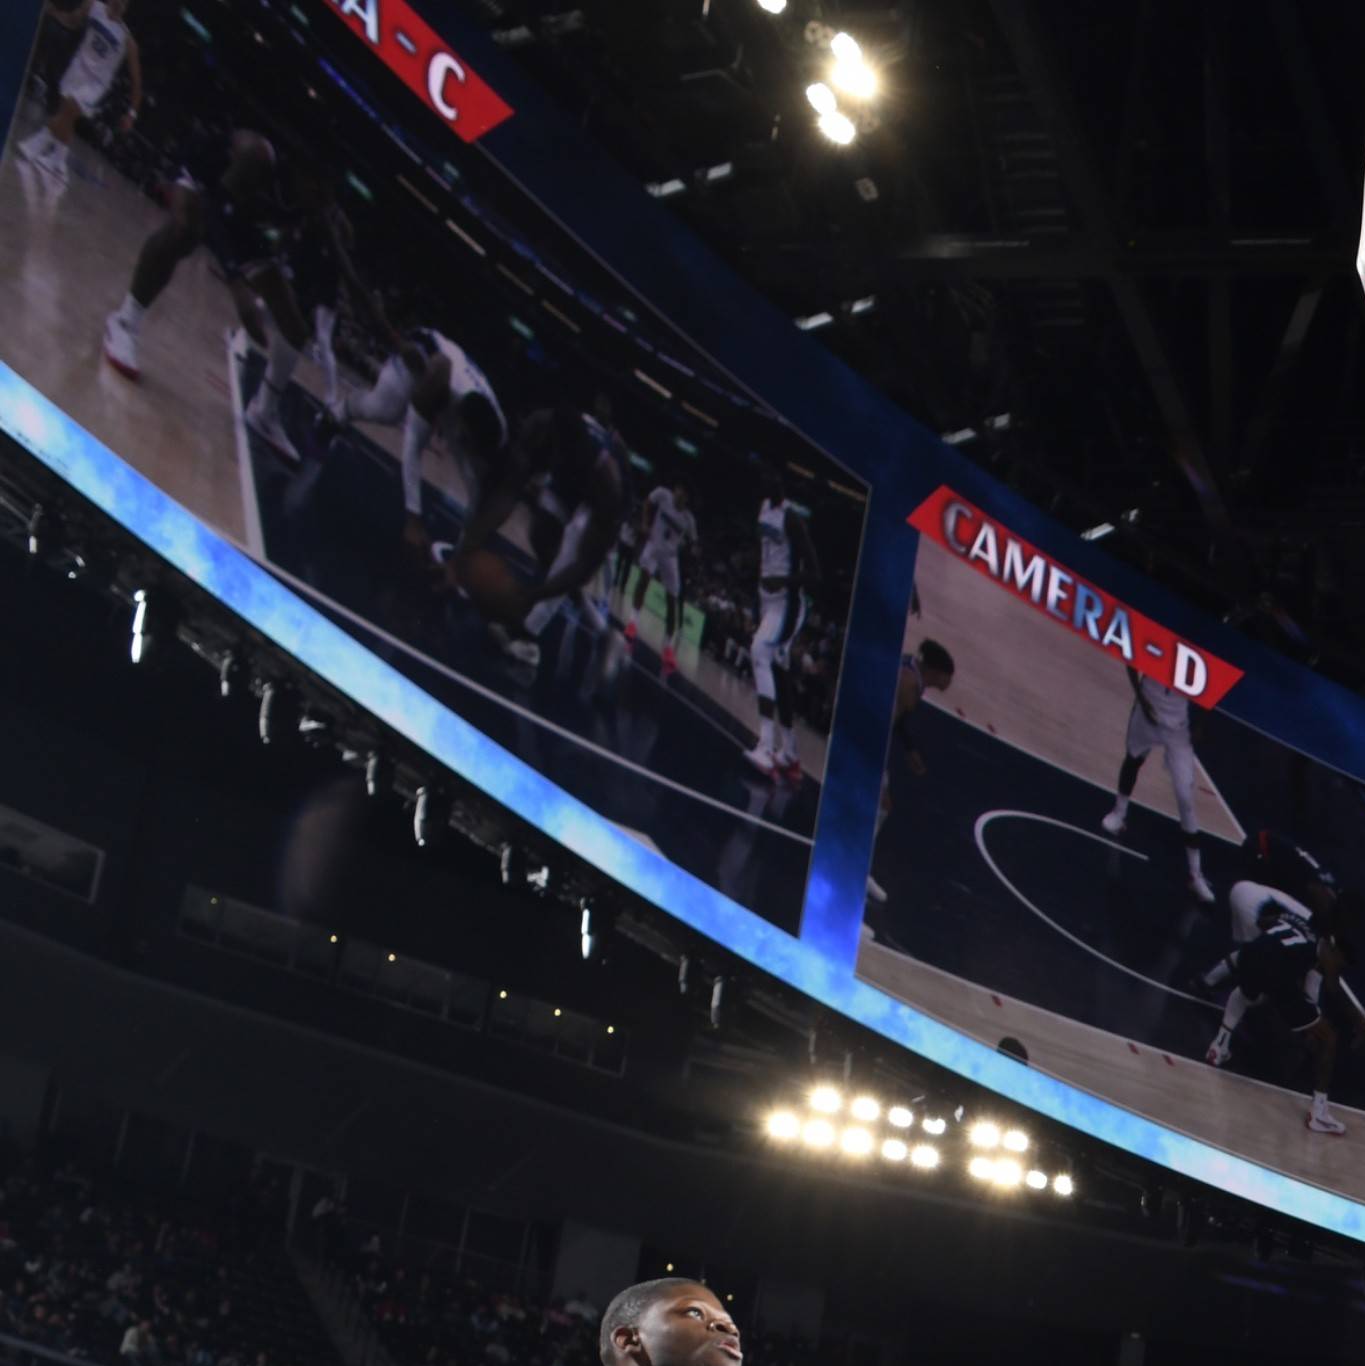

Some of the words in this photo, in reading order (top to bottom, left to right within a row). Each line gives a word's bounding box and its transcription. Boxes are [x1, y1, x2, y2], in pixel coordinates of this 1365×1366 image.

[426, 52, 467, 121] C
[942, 497, 1135, 661] CAMERA
[1173, 641, 1209, 698] D
